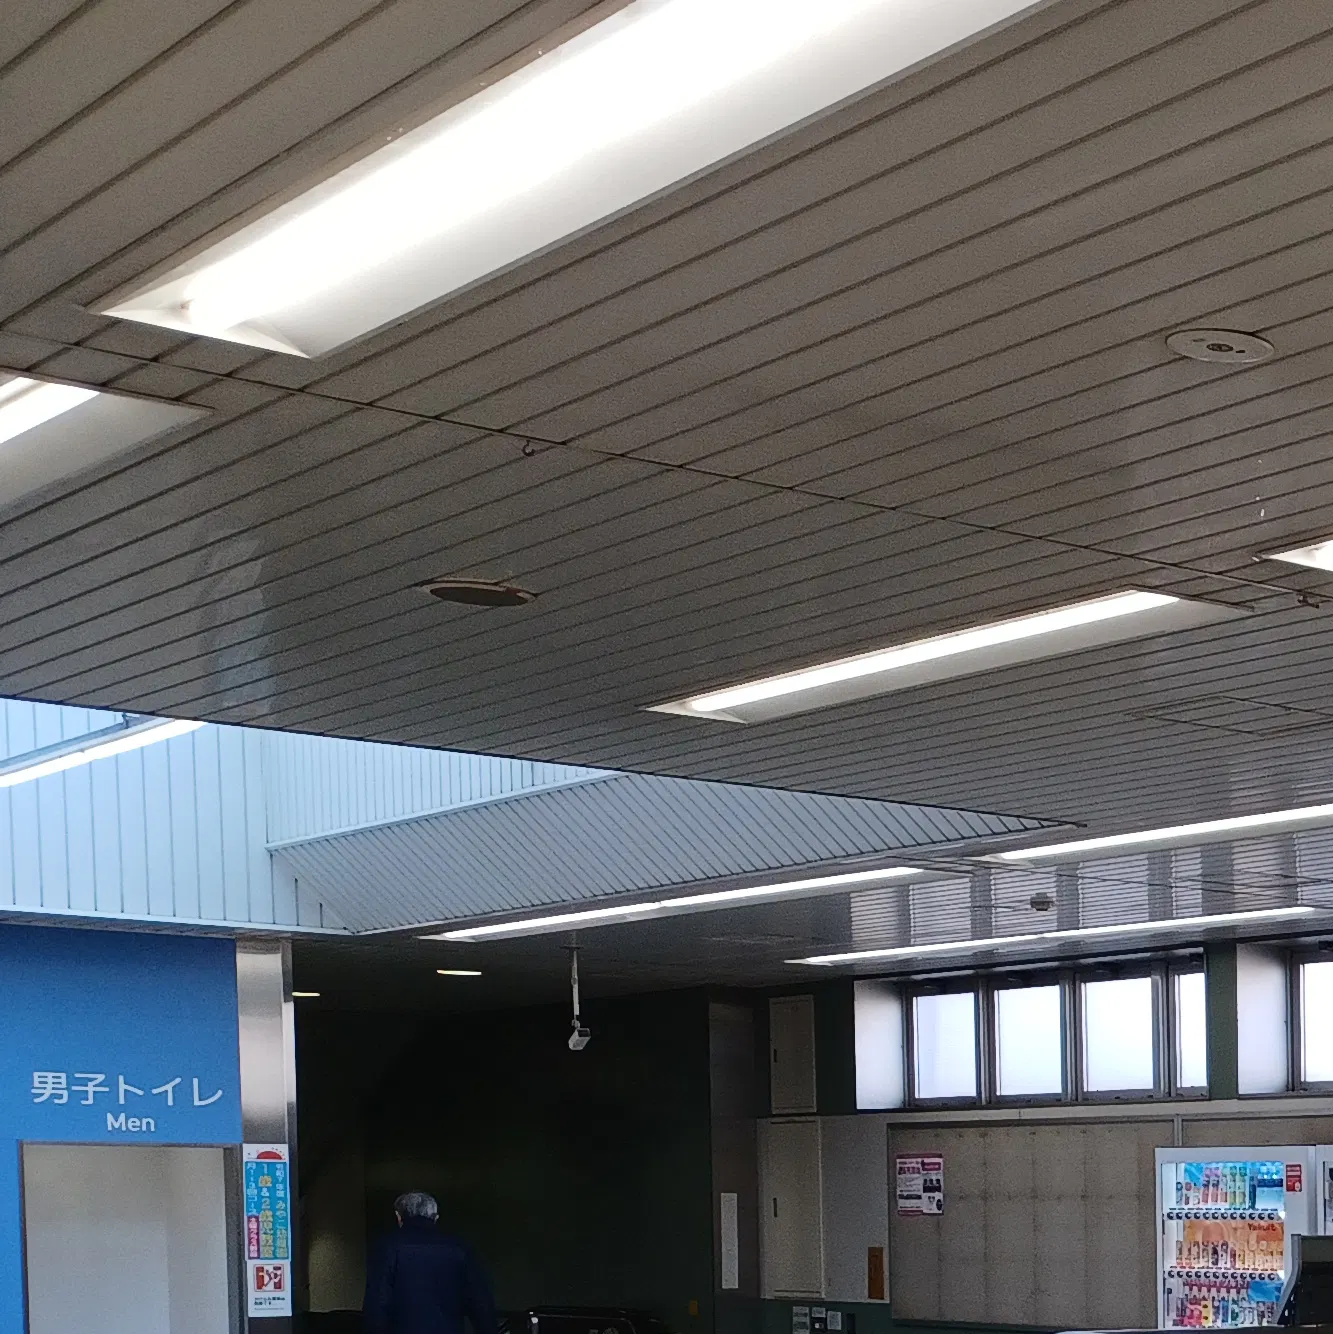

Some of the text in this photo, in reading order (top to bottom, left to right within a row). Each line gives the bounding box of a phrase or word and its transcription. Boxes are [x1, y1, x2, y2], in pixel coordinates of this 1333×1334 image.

[31, 1071, 223, 1106] 男子トイレ
[106, 1112, 156, 1132] Men
